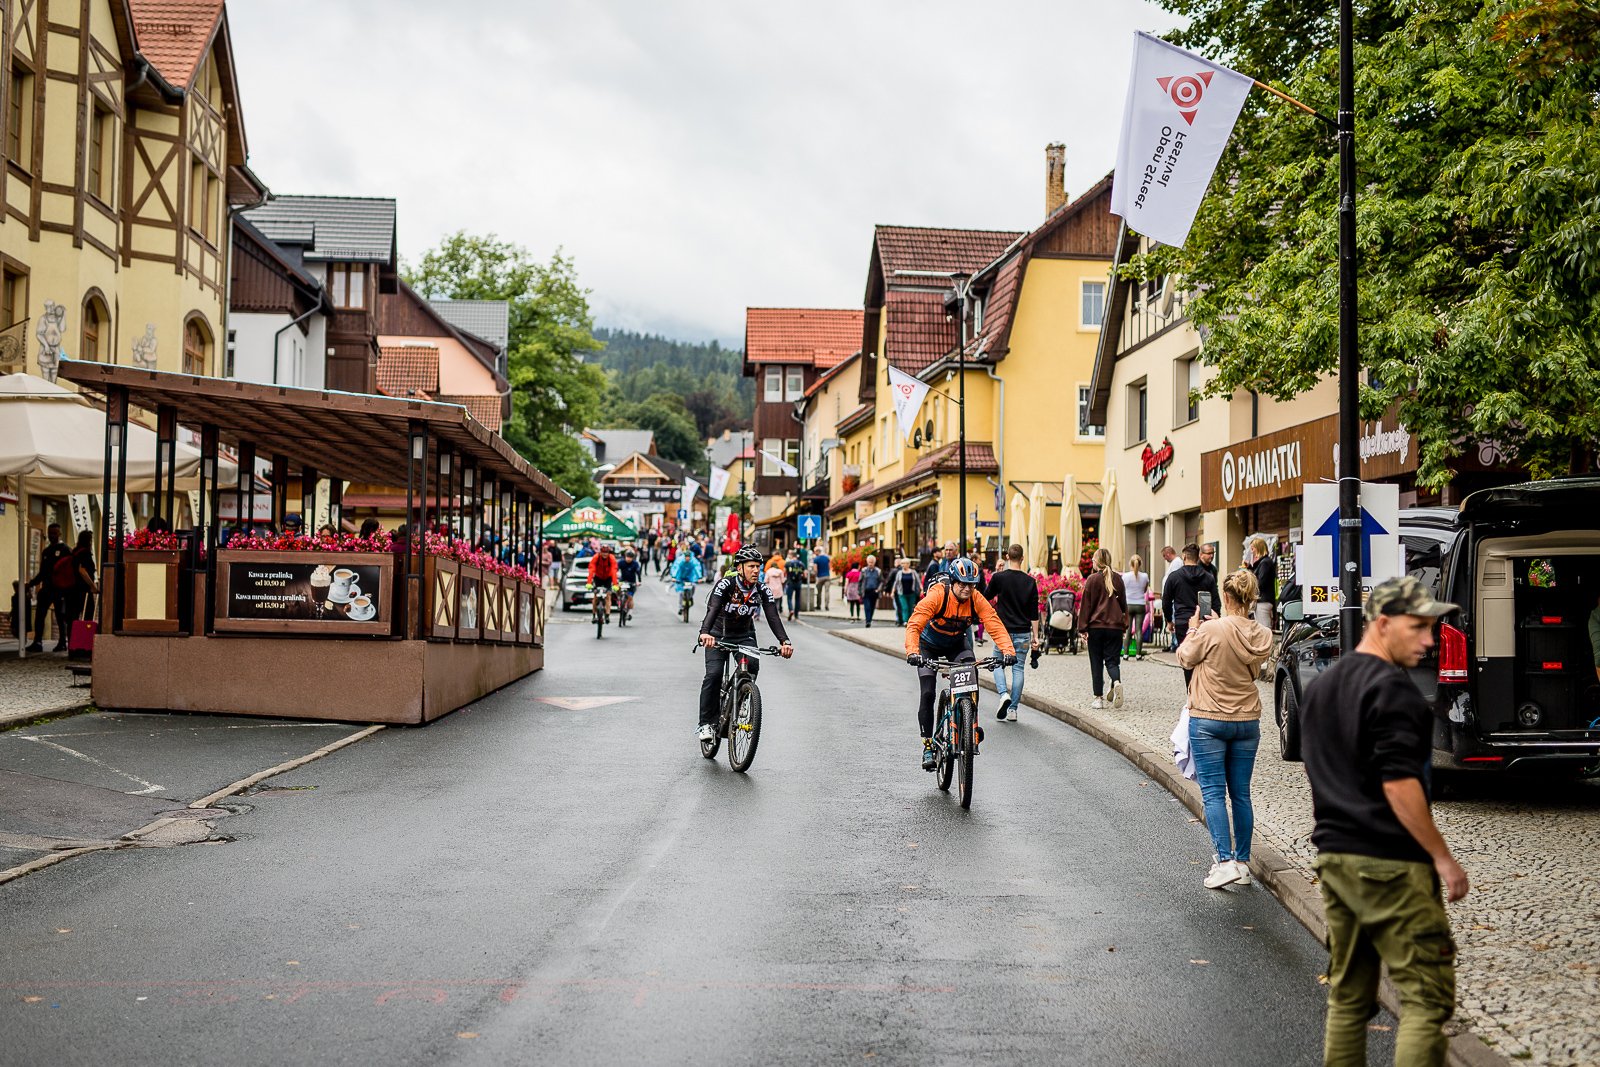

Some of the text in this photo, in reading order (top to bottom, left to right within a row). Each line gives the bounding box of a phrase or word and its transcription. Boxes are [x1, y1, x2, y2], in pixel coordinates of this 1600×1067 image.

[1238, 440, 1301, 491] PAMIĄTKI
[269, 571, 293, 580] pralinką
[282, 594, 306, 602] pralinką
[954, 672, 971, 683] 287
